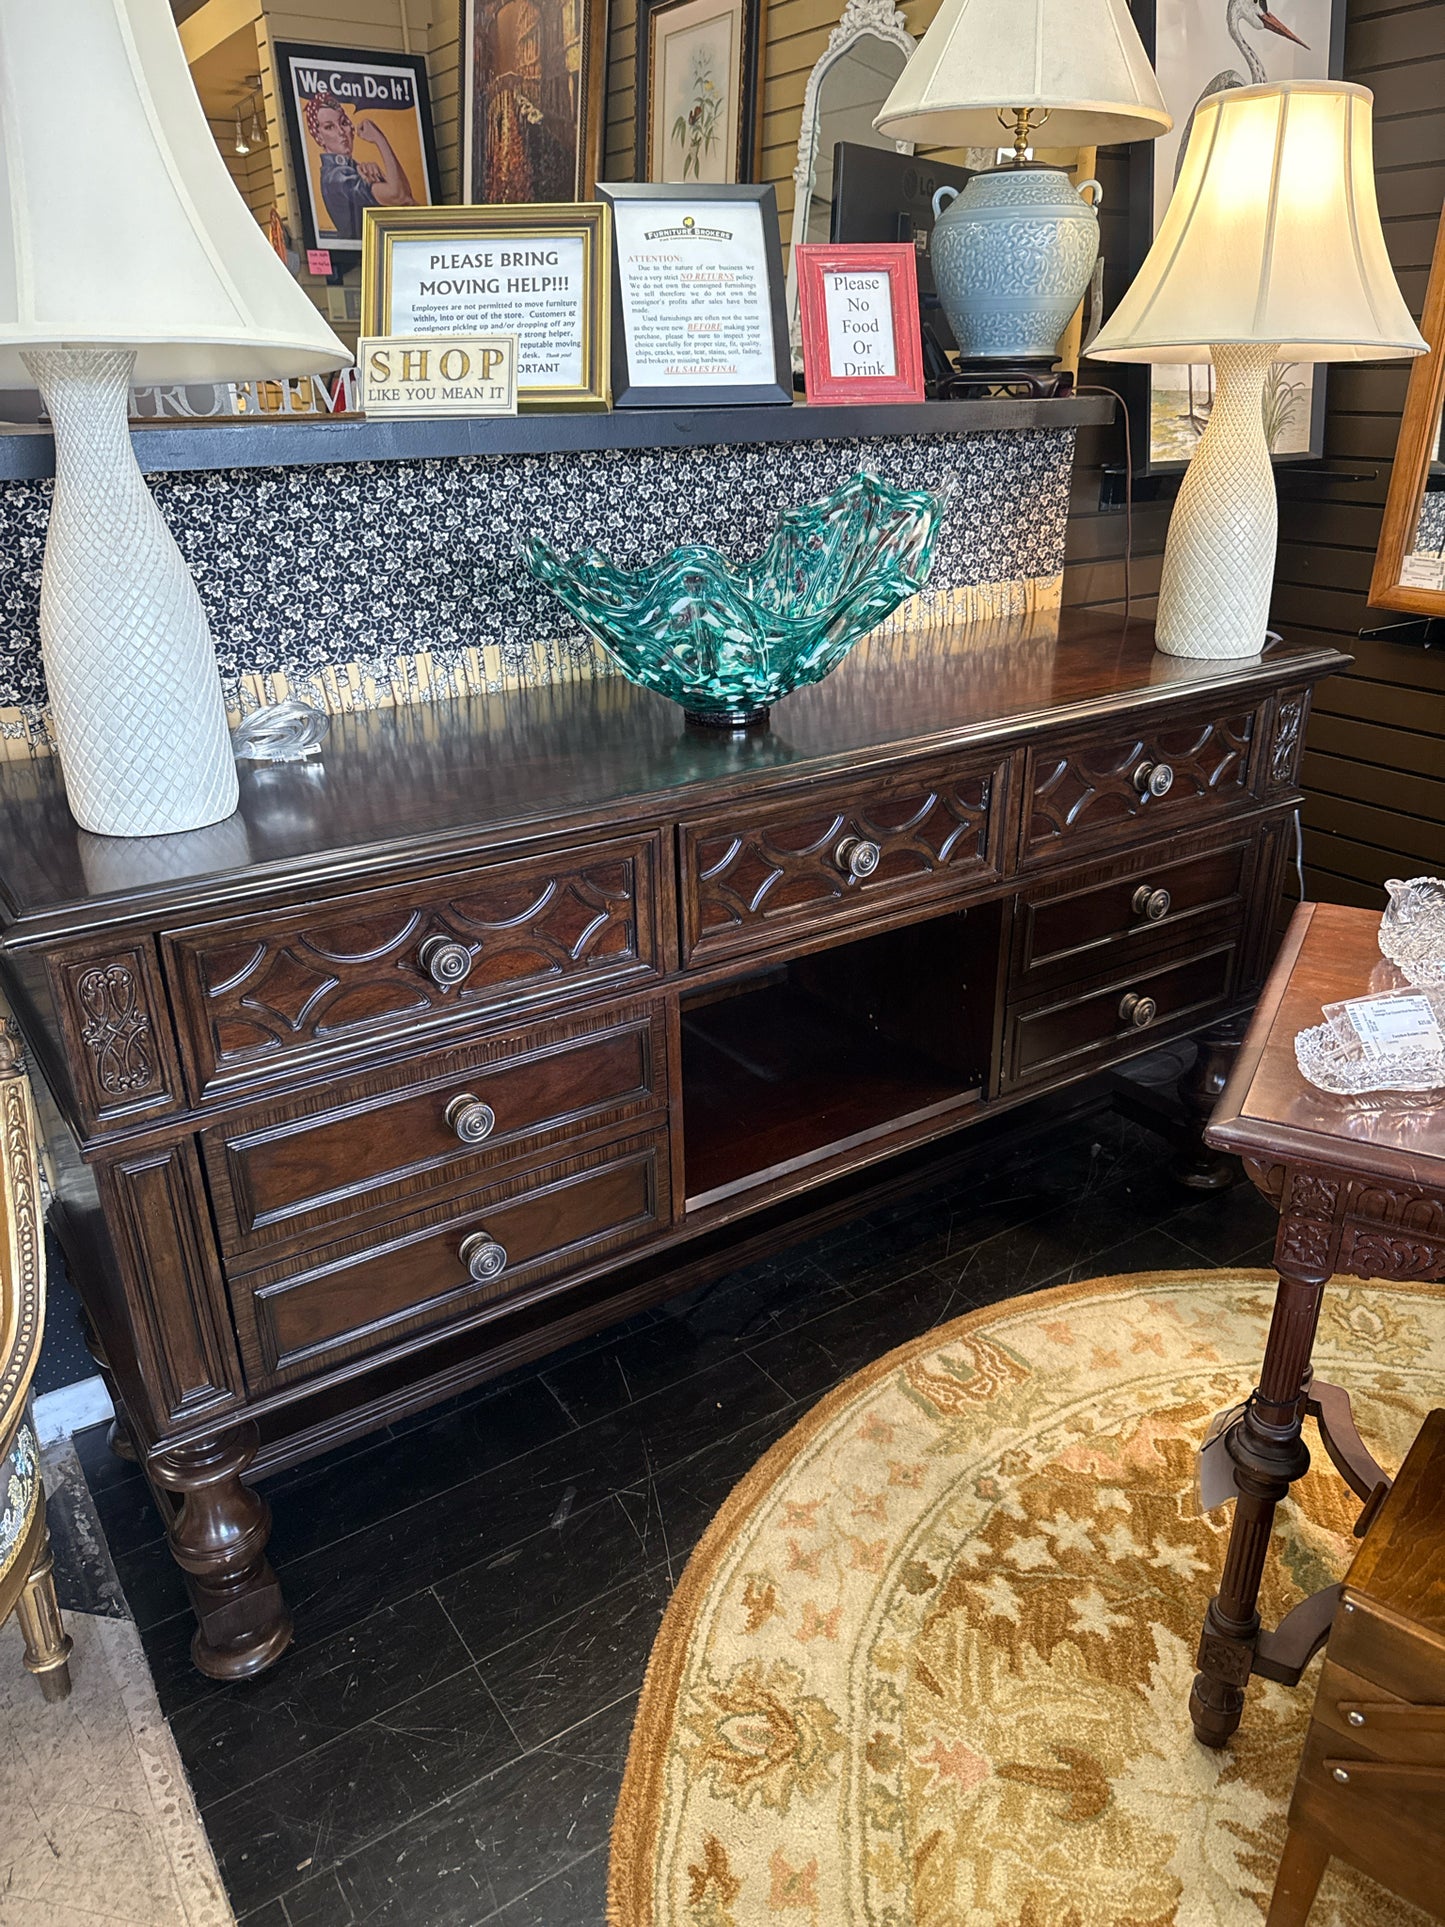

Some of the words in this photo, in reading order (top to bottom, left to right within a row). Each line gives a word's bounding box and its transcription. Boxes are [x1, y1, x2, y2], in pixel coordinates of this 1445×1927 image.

[299, 70, 327, 92] We
[329, 73, 362, 97] Can
[364, 76, 388, 99] Do
[390, 79, 409, 101] It!
[648, 228, 692, 239] FURNITURE
[695, 228, 730, 239] BROKERS
[430, 253, 493, 270] PLEASE
[500, 251, 558, 267] BRING
[680, 273, 693, 281] NO
[695, 273, 735, 281] RETURNS
[834, 276, 880, 291] Please
[420, 278, 500, 296] MOVING
[507, 276, 569, 293] HELP!!!
[412, 304, 448, 313] Employees
[479, 302, 512, 311] permitted
[848, 298, 870, 312] No
[413, 315, 437, 323] within,
[529, 310, 566, 318] Customers
[414, 324, 450, 332] consignors
[453, 323, 477, 332] picking
[491, 321, 514, 329] and/or
[517, 321, 548, 329] dropping
[688, 324, 722, 332] BEFORE
[842, 318, 880, 334] Food
[549, 330, 573, 338] helper.
[521, 341, 553, 349] reputable
[556, 340, 580, 348] moving
[853, 340, 872, 355] Or
[370, 348, 504, 383] SHOP
[518, 363, 560, 373] ORTANT
[664, 366, 679, 374] ALL
[683, 366, 709, 374] SALES
[711, 365, 737, 373] FINAL
[844, 362, 885, 376] Drink
[368, 389, 400, 401] LIKE
[407, 388, 437, 400] YOU
[441, 387, 484, 400] MEAN
[490, 387, 504, 399] IT
